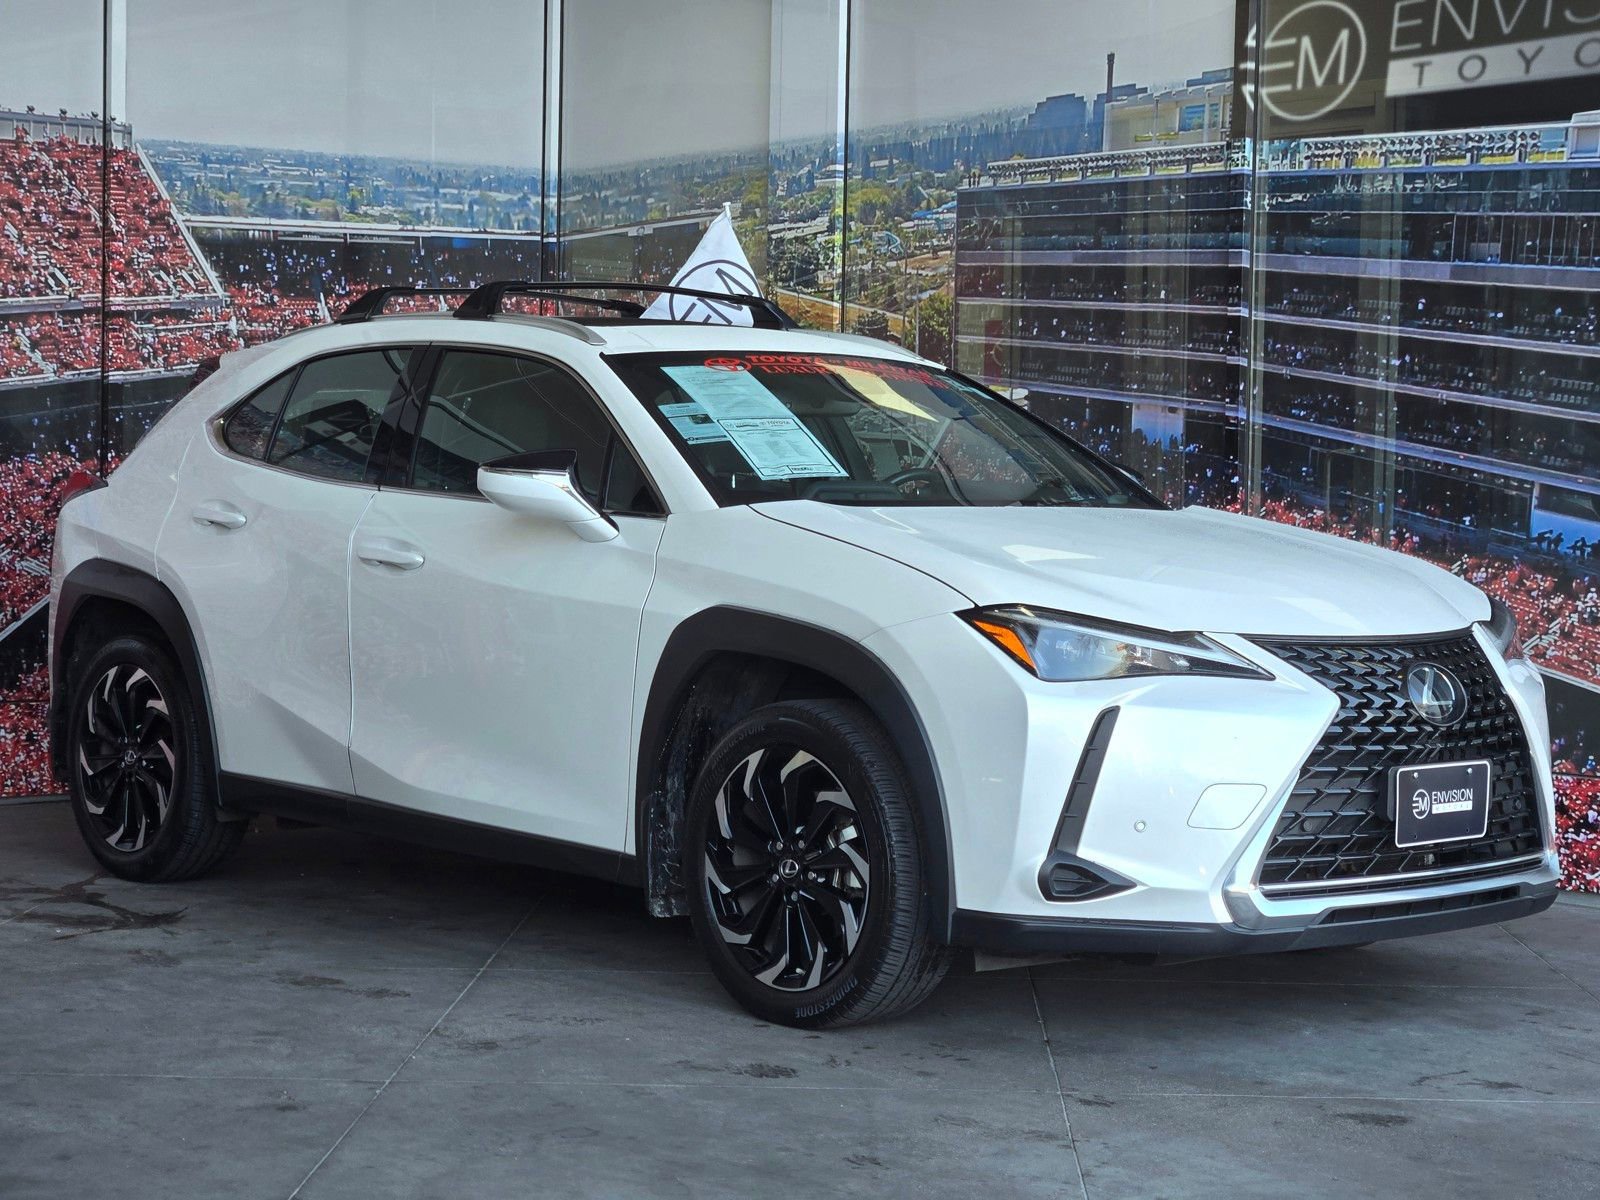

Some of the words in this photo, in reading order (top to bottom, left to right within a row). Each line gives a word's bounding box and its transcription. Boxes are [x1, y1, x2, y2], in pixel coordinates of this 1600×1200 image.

[1390, 0, 1600, 51] ENVI
[1412, 38, 1600, 89] TOYO
[745, 354, 825, 364] TOYOTA
[1431, 788, 1473, 804] ENVISION
[795, 975, 858, 1018] BRIDGESTONE
